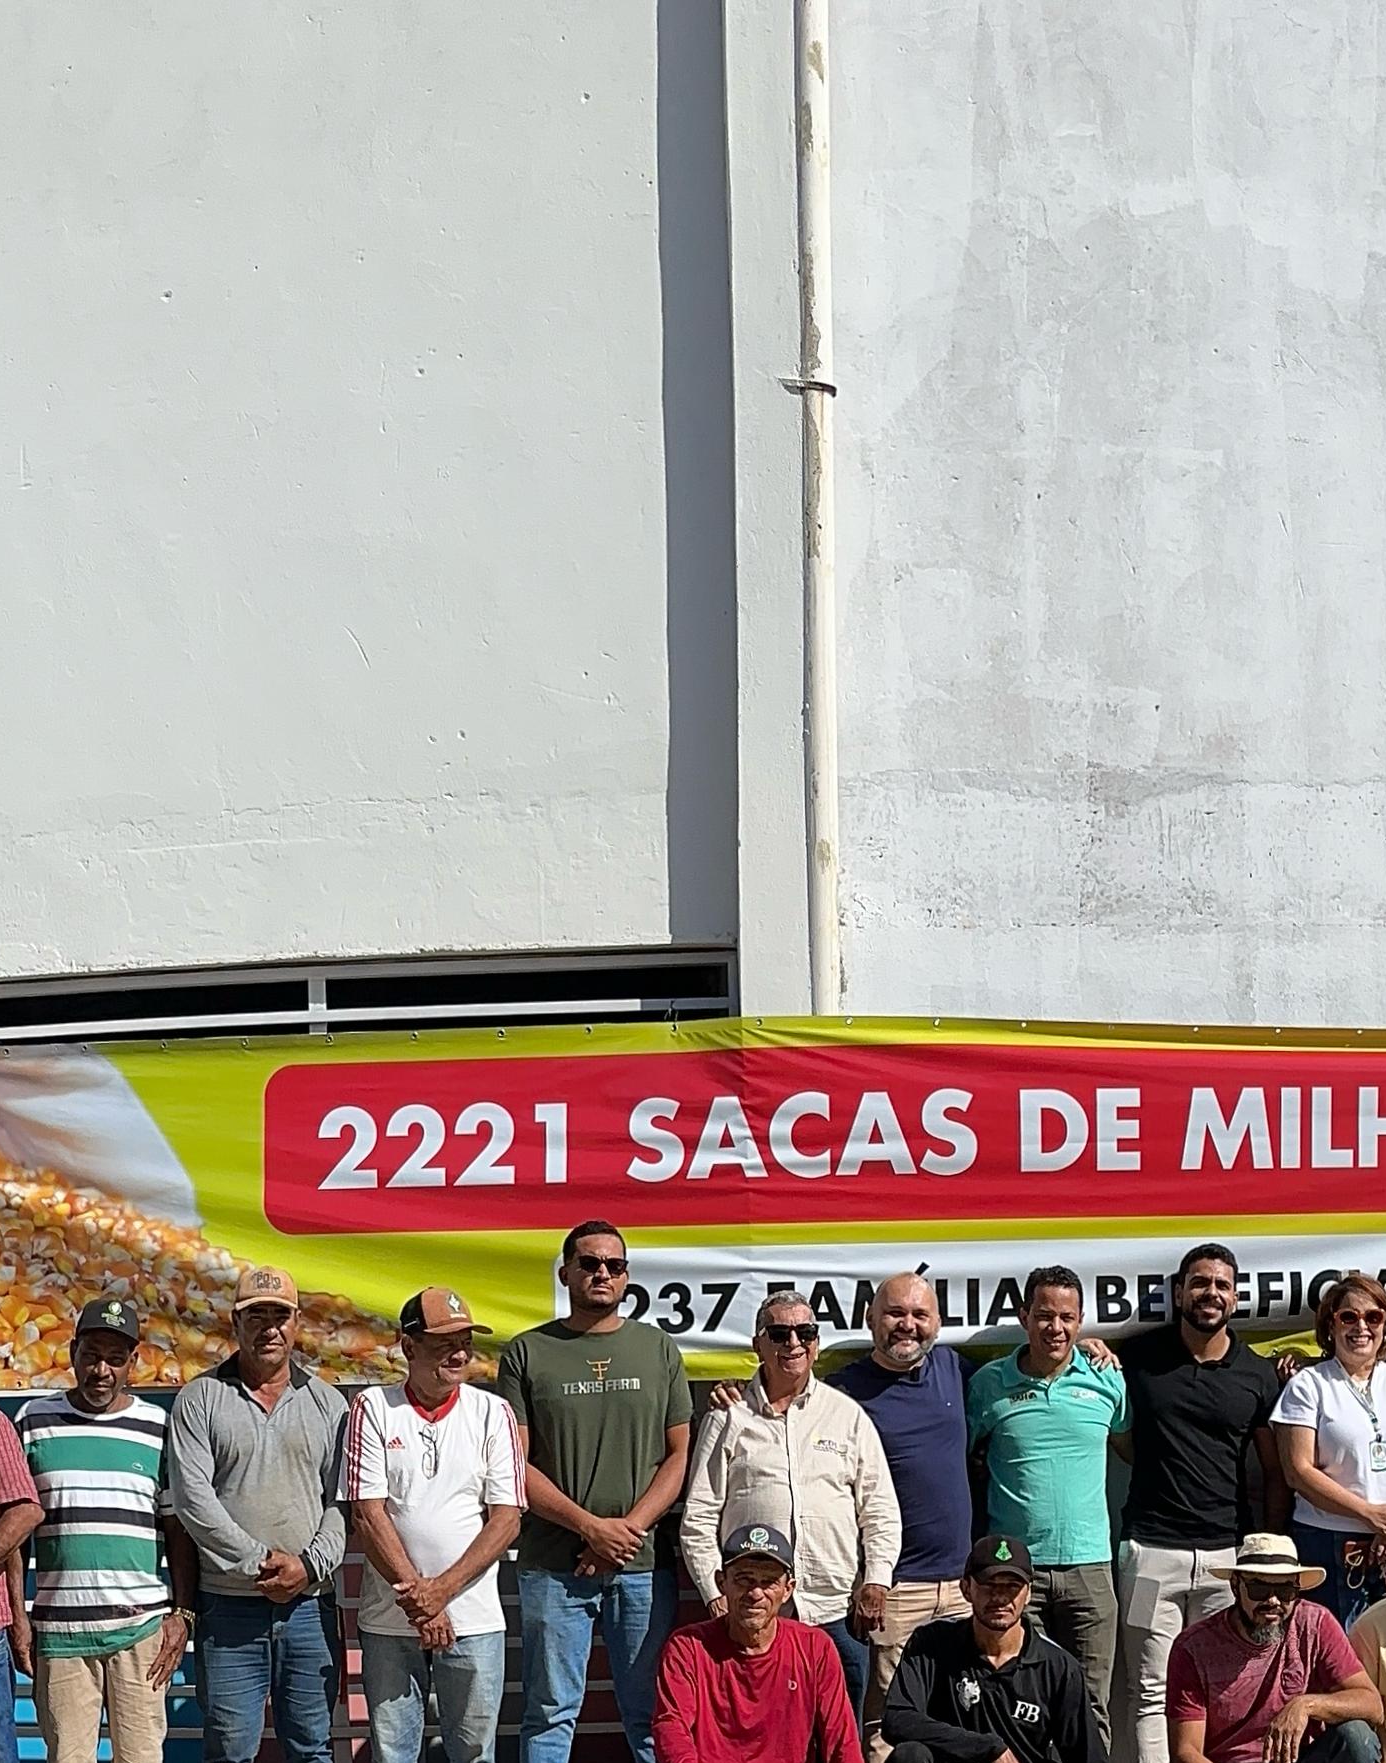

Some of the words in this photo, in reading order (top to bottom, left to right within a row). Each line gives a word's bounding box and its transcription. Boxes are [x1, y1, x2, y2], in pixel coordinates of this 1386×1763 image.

[317, 1101, 568, 1191] 2221
[626, 1088, 979, 1182] SACAS
[1019, 1088, 1142, 1172] DE
[562, 1381, 603, 1395] TEXAS
[605, 1378, 641, 1392] FARM
[1012, 1700, 1040, 1723] FB
